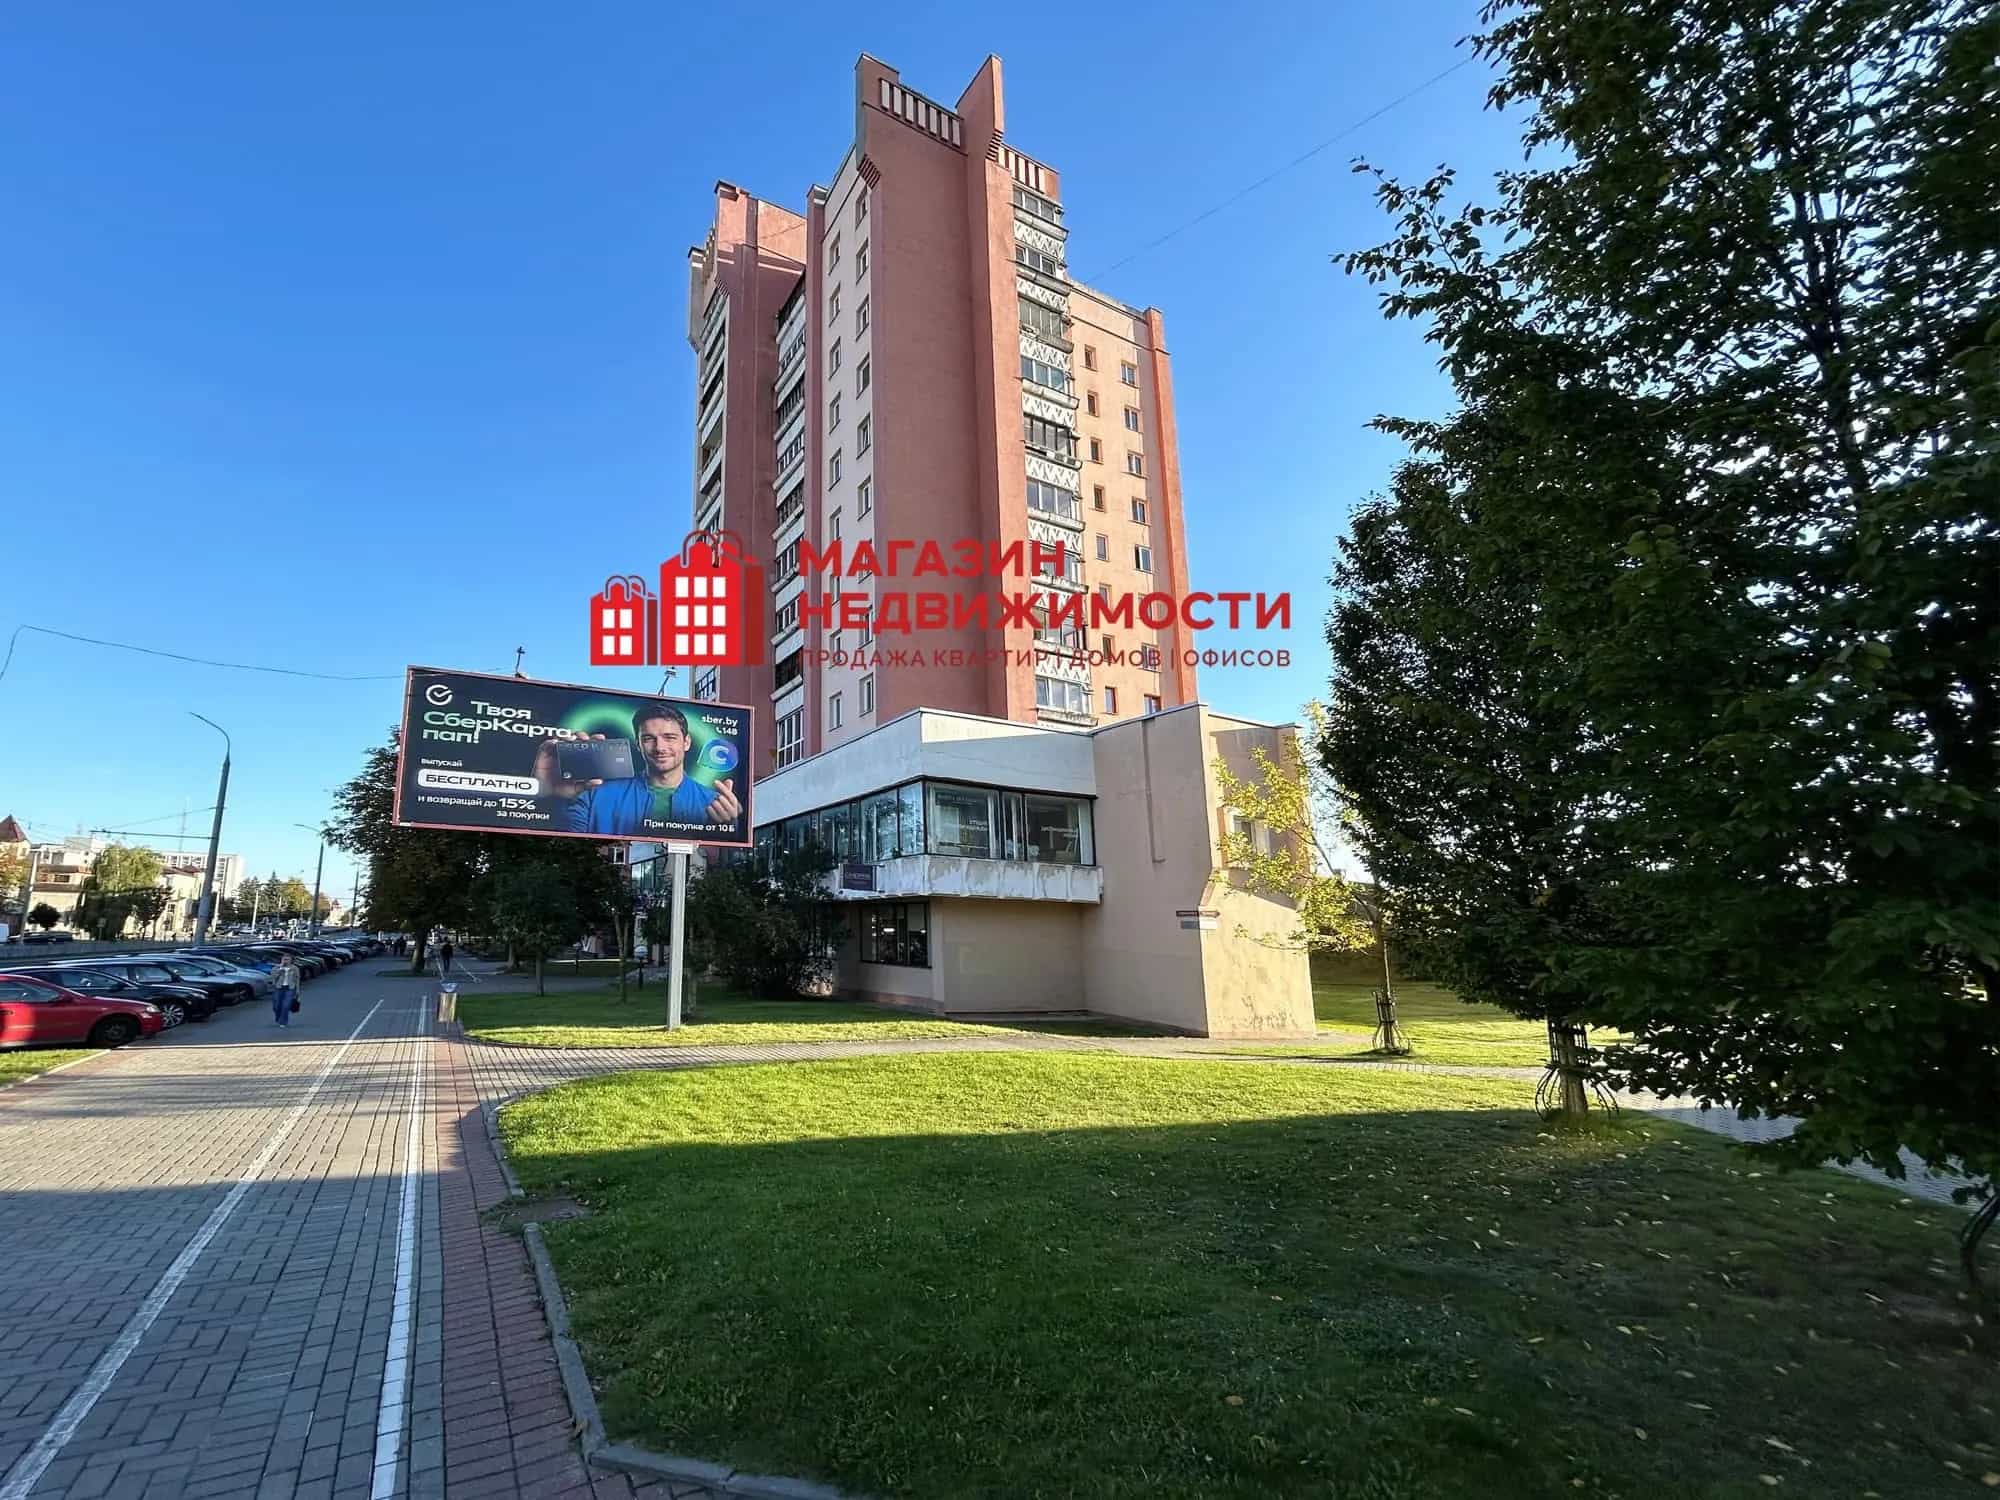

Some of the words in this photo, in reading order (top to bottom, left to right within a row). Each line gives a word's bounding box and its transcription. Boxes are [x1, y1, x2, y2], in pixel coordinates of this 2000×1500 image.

[470, 700, 532, 719] Твоя
[702, 714, 738, 727] sber.by
[422, 728, 480, 744] пап!
[421, 758, 462, 767] выпускай
[425, 774, 532, 790] БЕСПЛАТНО
[427, 796, 482, 807] возвращай
[498, 797, 536, 810] 15%
[509, 811, 550, 820] покупки
[644, 819, 664, 828] При
[666, 821, 704, 831] покупке
